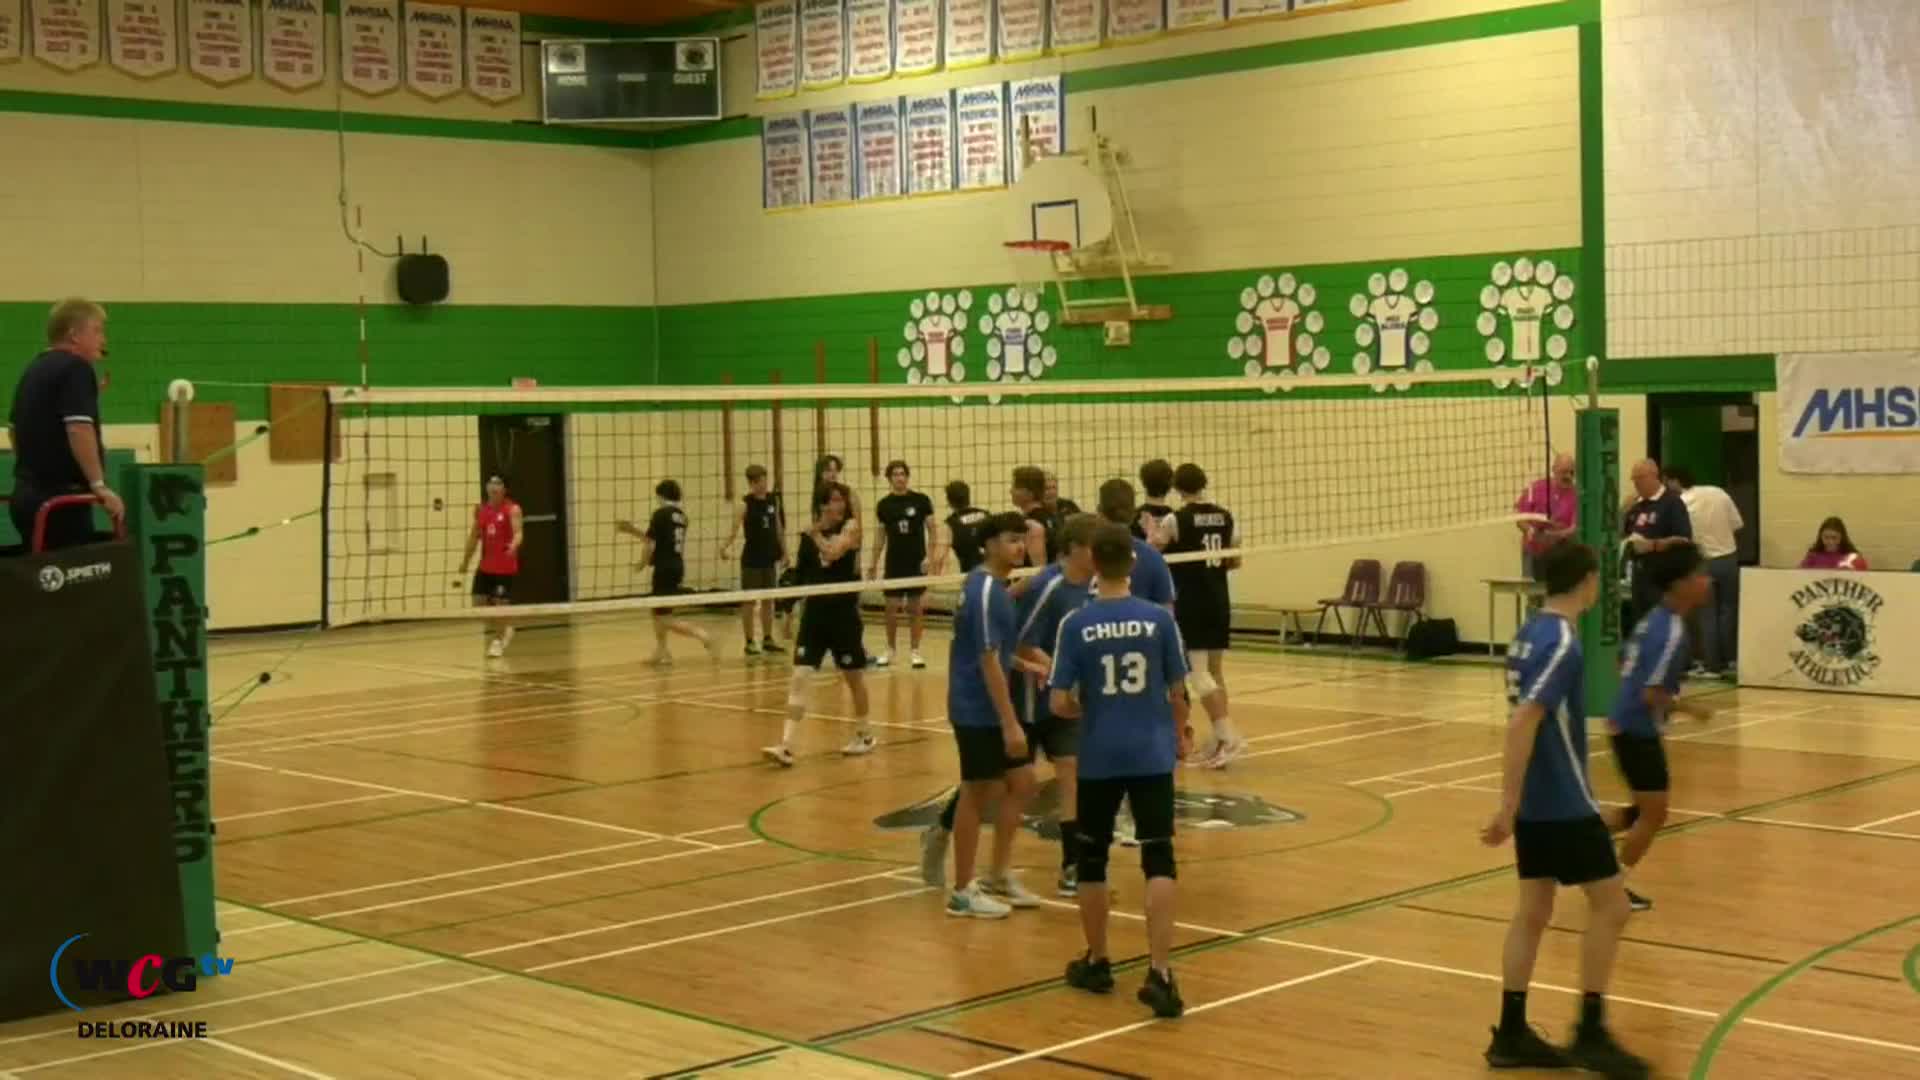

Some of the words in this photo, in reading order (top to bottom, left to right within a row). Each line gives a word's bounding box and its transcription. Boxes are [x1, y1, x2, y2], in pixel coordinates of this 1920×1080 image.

[1792, 386, 1920, 437] MHS
[1791, 578, 1884, 612] PANTHER
[1081, 620, 1157, 642] CHUDY
[1101, 652, 1147, 695] 13
[1788, 650, 1881, 686] ATHLETICS
